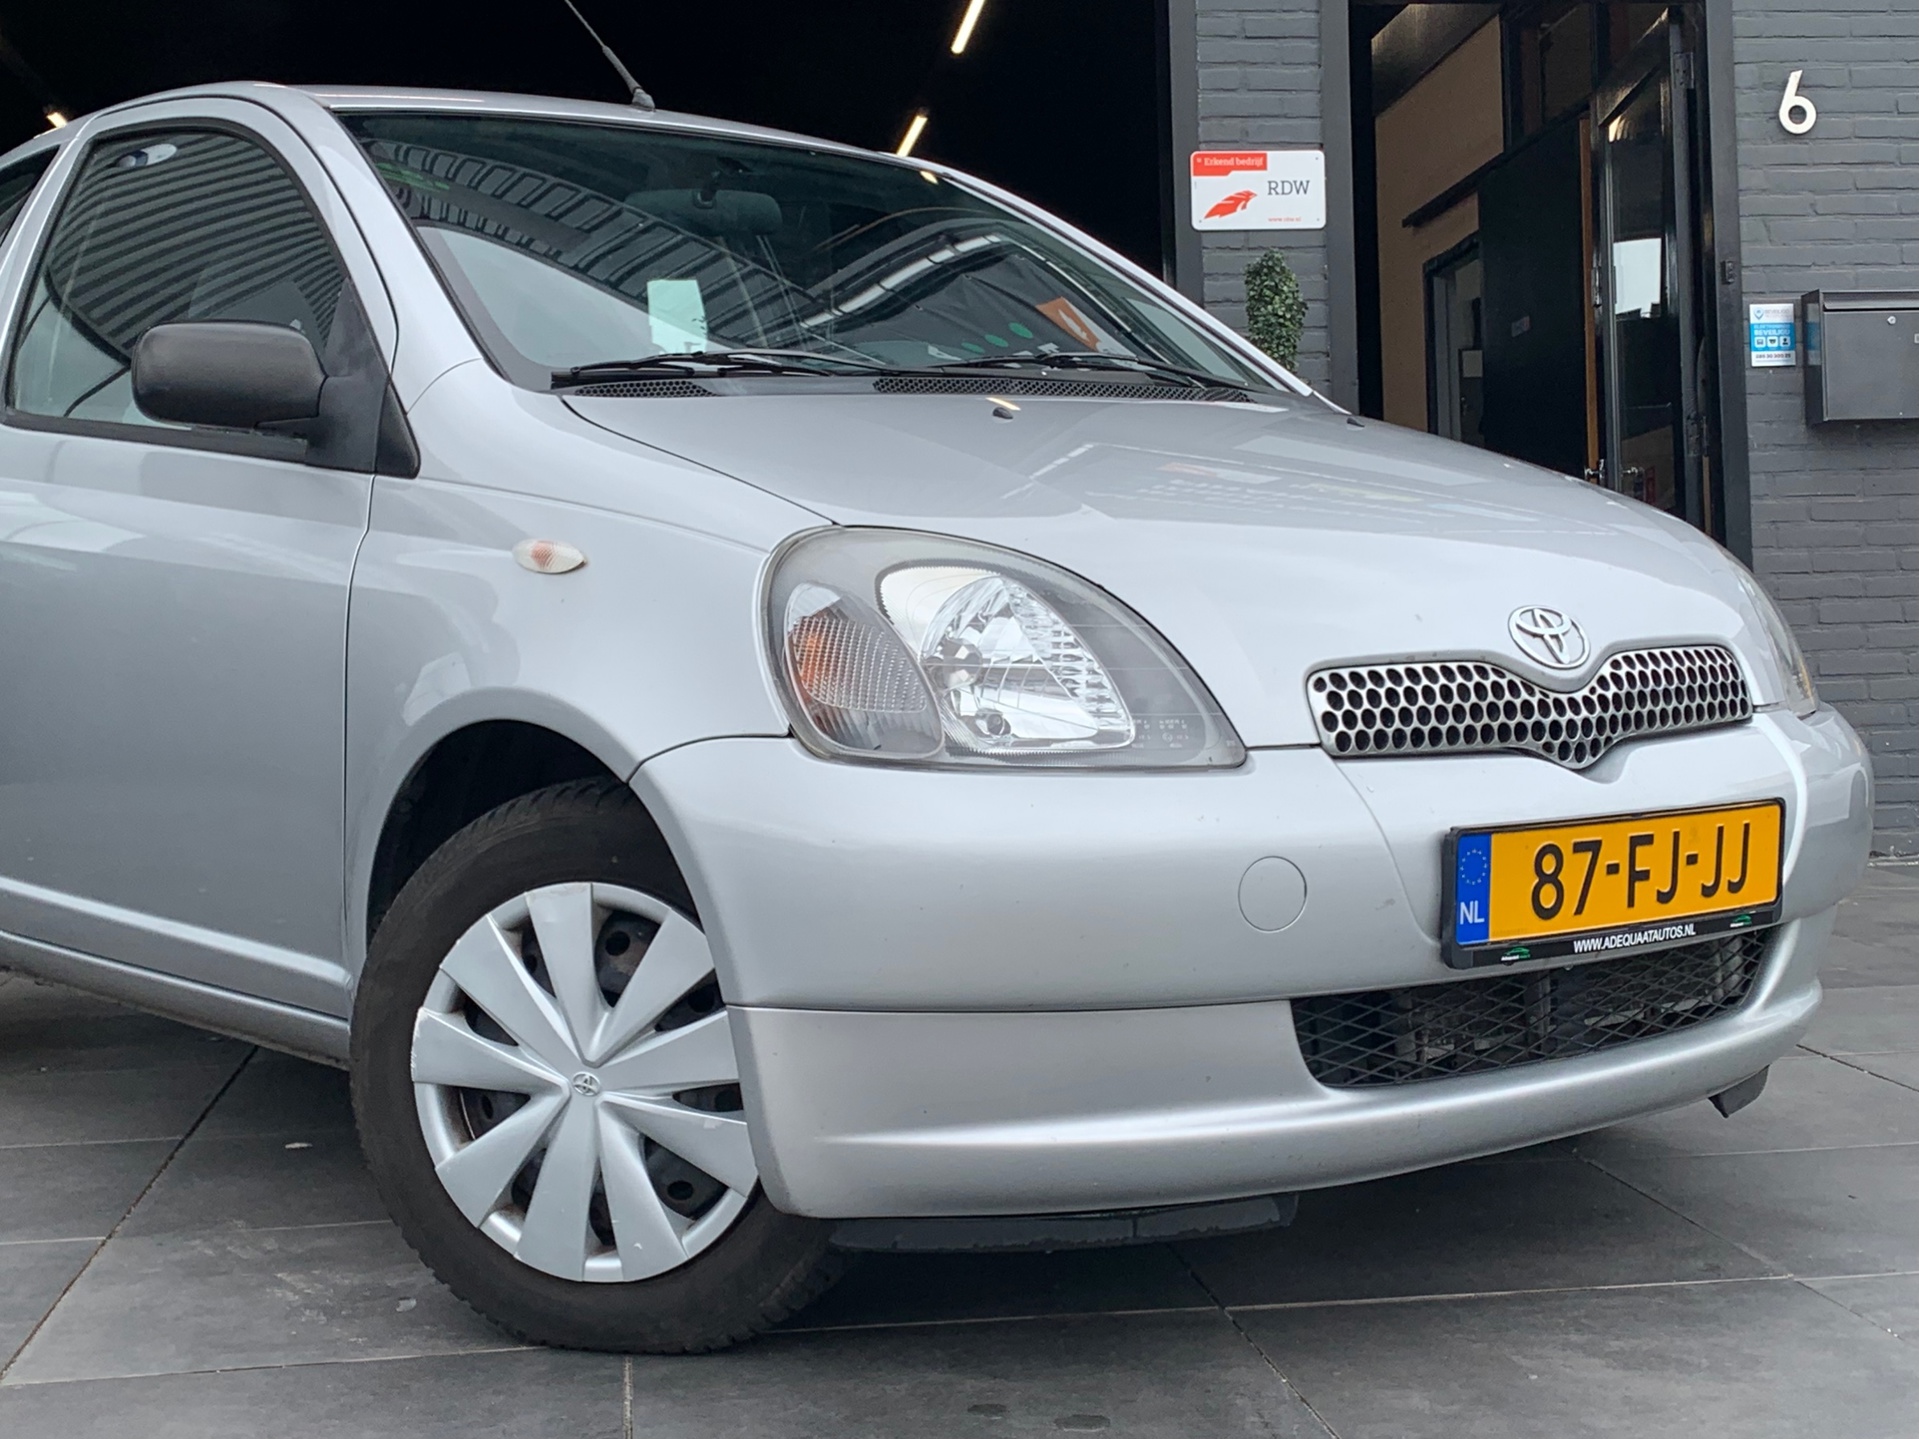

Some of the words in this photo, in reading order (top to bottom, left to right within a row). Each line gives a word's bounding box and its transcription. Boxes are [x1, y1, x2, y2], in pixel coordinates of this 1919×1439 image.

[1779, 69, 1816, 134] 6
[1204, 157, 1234, 166] Erkend
[1235, 156, 1263, 168] bedrijf
[1267, 180, 1310, 195] RDW
[1531, 822, 1750, 921] 87-FJ-JJ
[1459, 901, 1485, 924] NL
[1573, 923, 1696, 953] WWW.ADEQUAATAUTOS.NL
